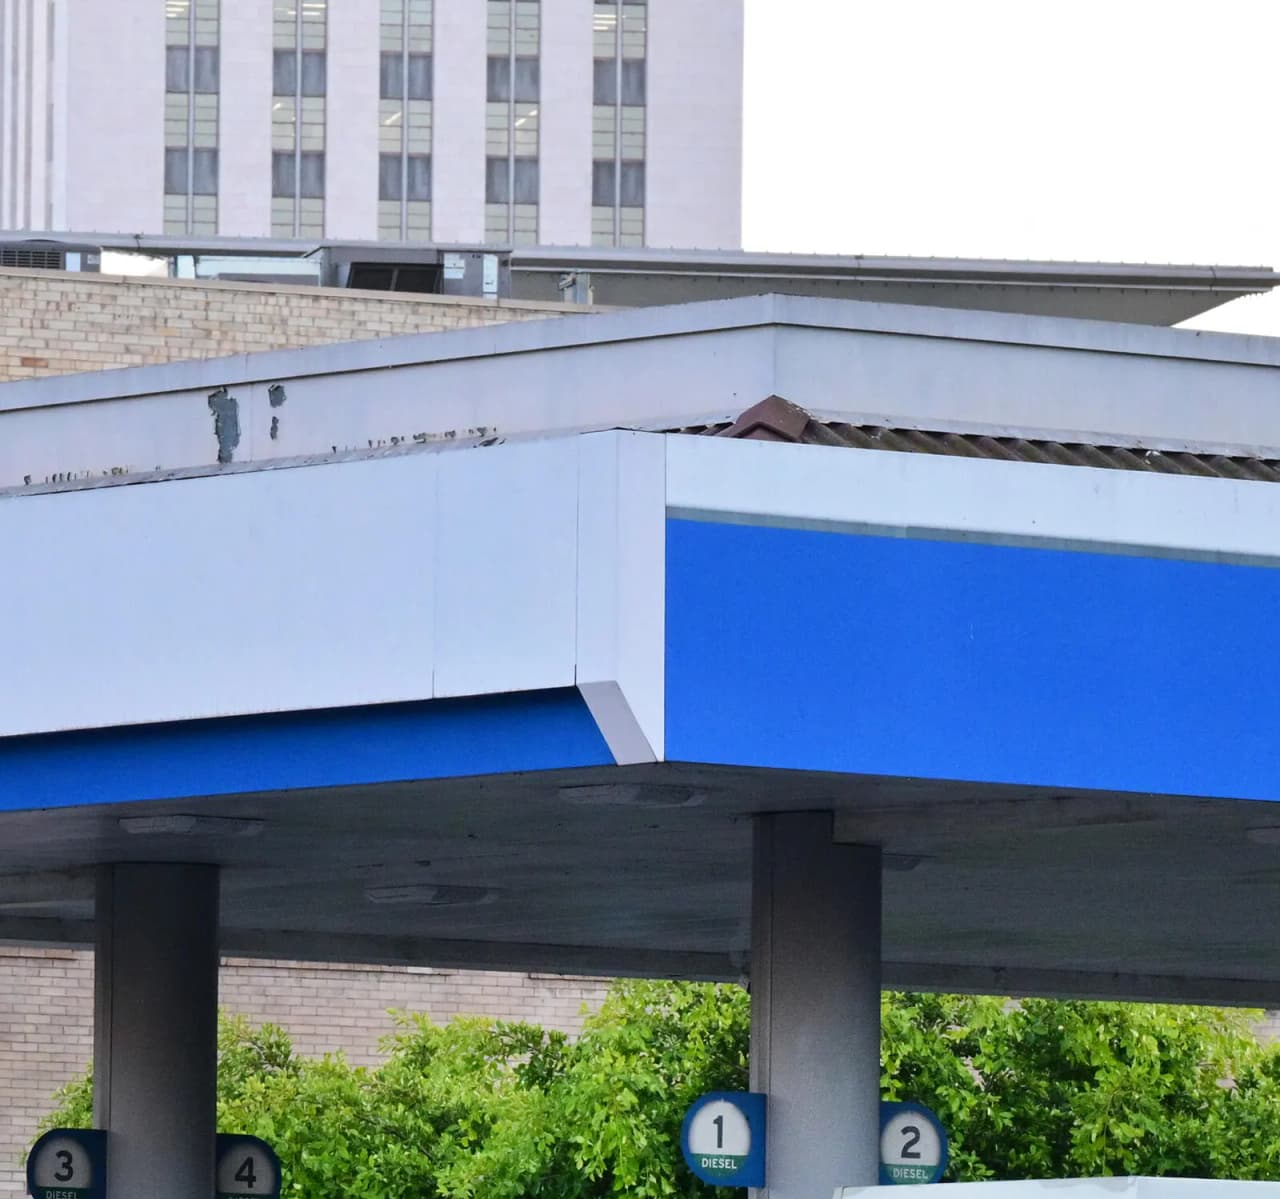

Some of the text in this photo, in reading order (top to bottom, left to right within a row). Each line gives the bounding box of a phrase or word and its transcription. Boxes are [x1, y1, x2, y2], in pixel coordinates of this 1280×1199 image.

[712, 1115, 724, 1149] 1
[900, 1126, 921, 1159] 2
[54, 1150, 74, 1182] 3
[234, 1157, 257, 1189] 4
[701, 1158, 737, 1170] DIESEL
[892, 1168, 928, 1180] DIESEL
